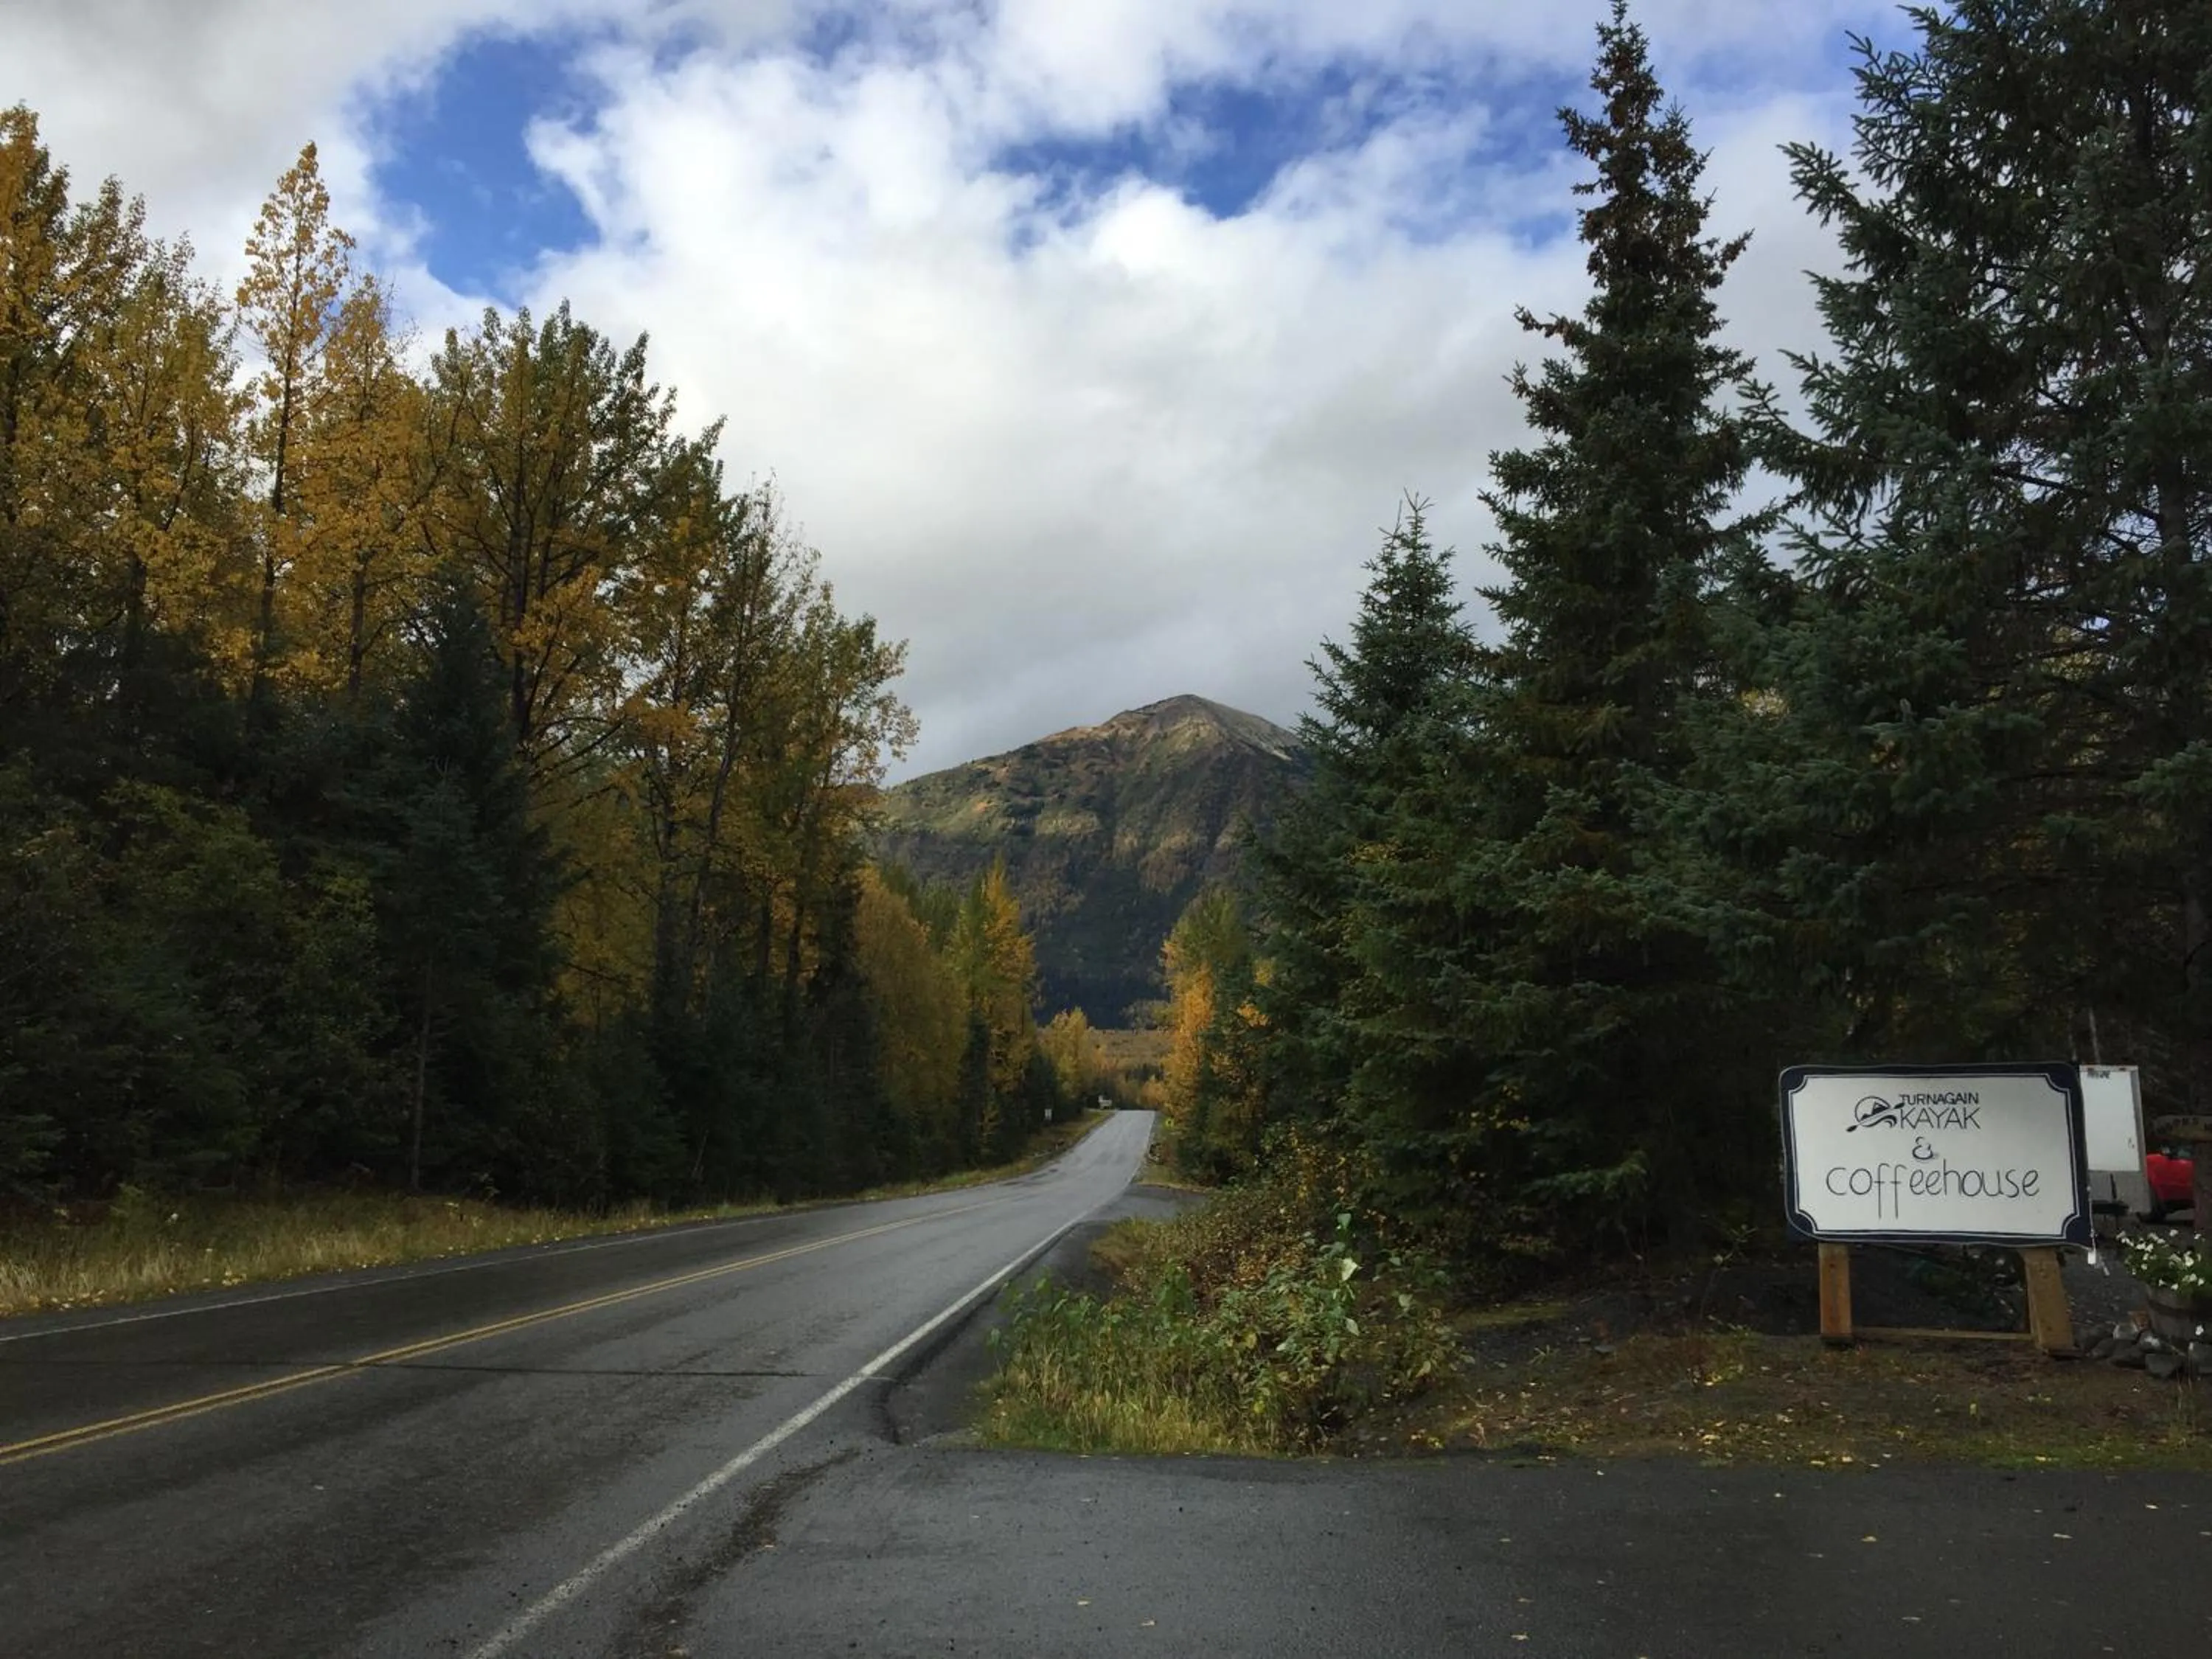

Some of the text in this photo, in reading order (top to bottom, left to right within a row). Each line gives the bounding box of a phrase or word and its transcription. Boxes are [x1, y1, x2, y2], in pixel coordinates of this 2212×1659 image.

[1899, 1092, 1979, 1105] TURNAGAIN
[1899, 1107, 1981, 1130] KAYAK
[1912, 1136, 1938, 1160] &
[1826, 1158, 2040, 1220] coffeehouse
